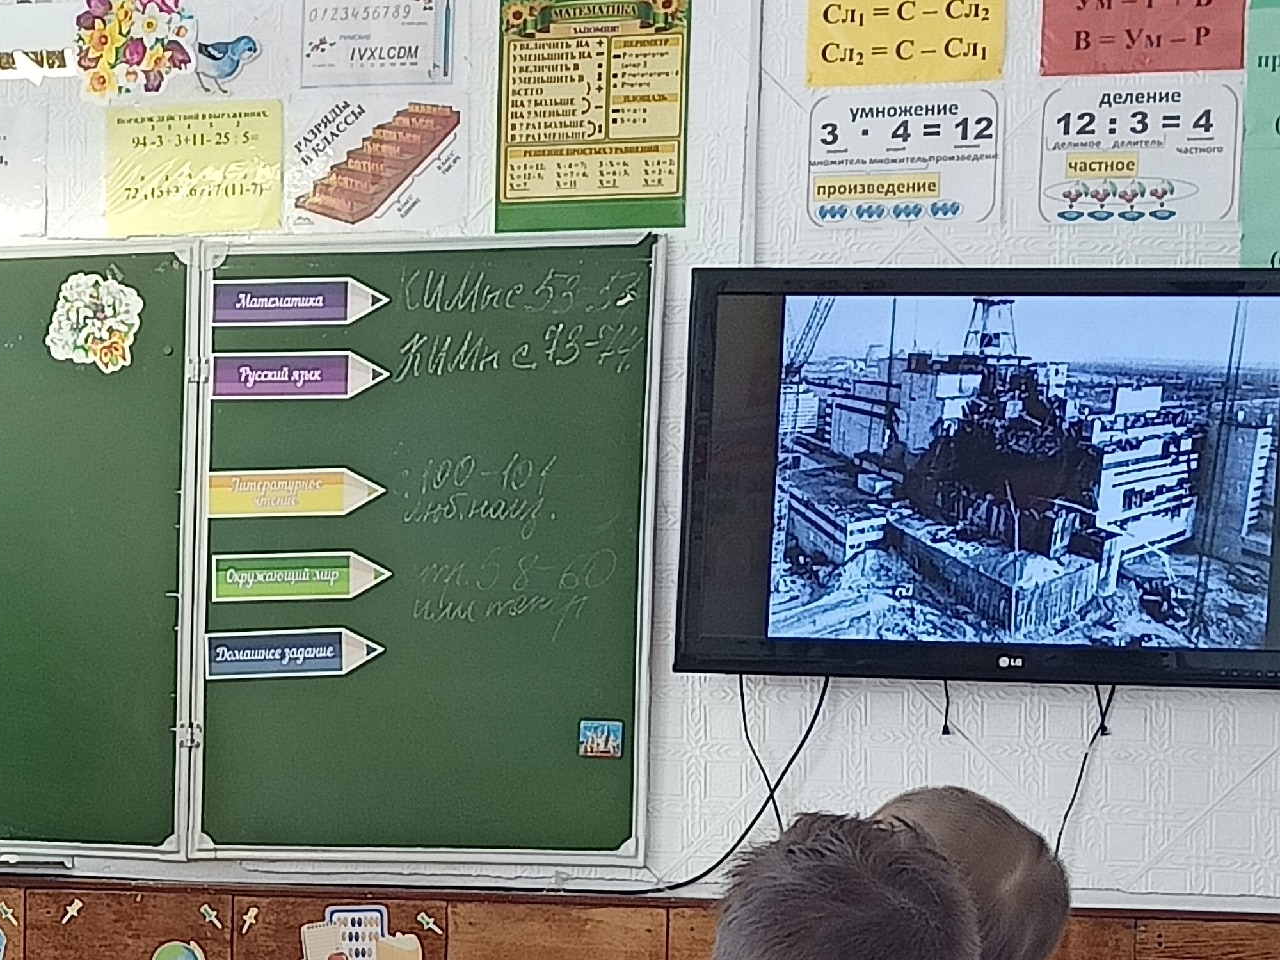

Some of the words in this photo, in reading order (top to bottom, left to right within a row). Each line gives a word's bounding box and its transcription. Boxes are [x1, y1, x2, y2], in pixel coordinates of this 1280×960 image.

[553, 4, 637, 18] МАТЕМАТИКА
[897, 0, 916, 21] С
[1075, 30, 1091, 50] В
[1125, 29, 1162, 49] Ум
[1195, 26, 1210, 46] Р
[895, 40, 915, 60] С
[1099, 91, 1181, 108] деление
[850, 103, 959, 122] умножение
[1056, 112, 1096, 135] 12
[1129, 111, 1149, 134] 3
[1192, 109, 1214, 133] 4
[293, 100, 352, 153] РАЗРЯДЫ
[820, 123, 838, 145] 3
[891, 120, 911, 142] 4
[954, 117, 993, 140] 12
[1053, 140, 1101, 150] делимое
[1112, 140, 1163, 149] делитель
[1068, 161, 1136, 173] частное
[816, 181, 937, 198] произведение
[235, 293, 324, 309] Математика
[239, 366, 290, 388] Русский
[290, 368, 322, 388] язык
[230, 477, 324, 497] Литературное
[226, 568, 310, 588] Окружающий
[312, 570, 340, 586] мир
[215, 647, 282, 661] Домашнее
[281, 645, 335, 665] задание
